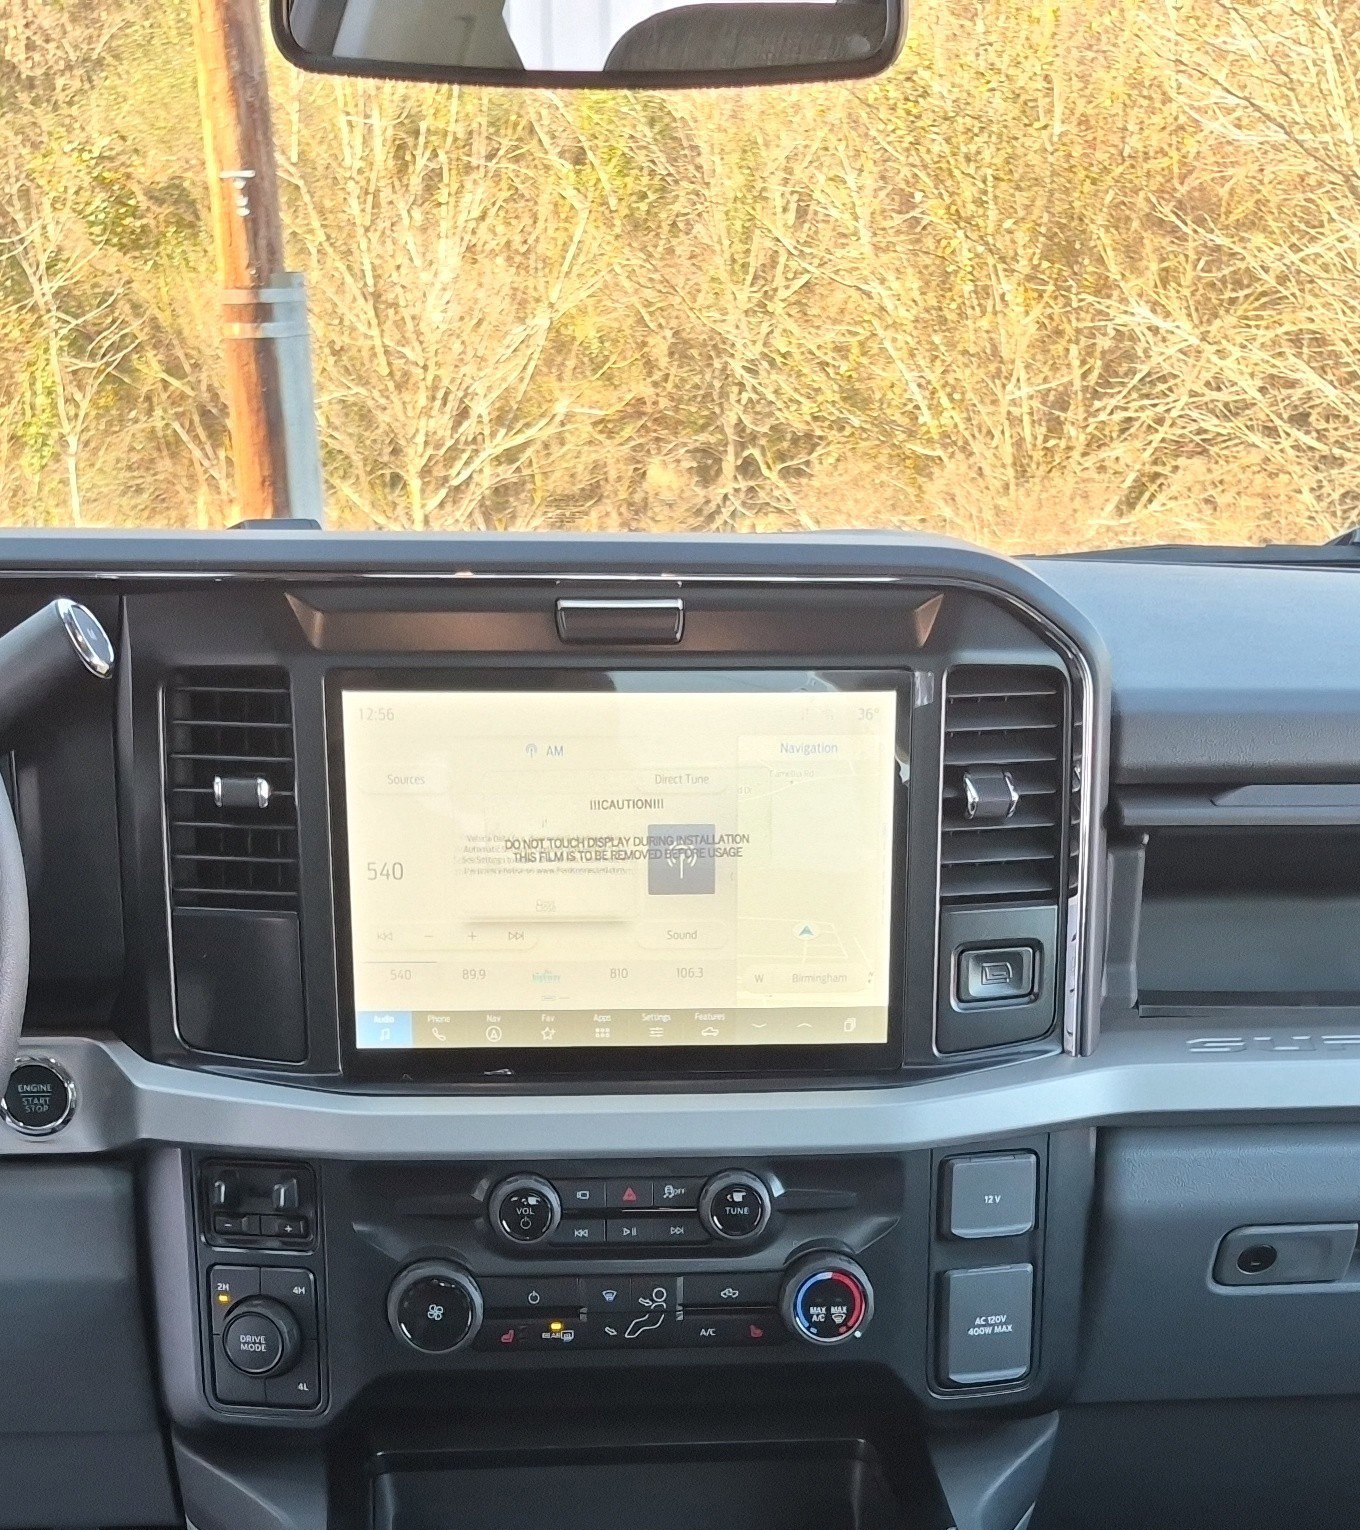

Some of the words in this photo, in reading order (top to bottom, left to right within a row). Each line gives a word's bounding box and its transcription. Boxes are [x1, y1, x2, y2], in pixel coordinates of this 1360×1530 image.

[358, 707, 395, 721] 12:56
[546, 745, 564, 757] AM
[779, 742, 839, 756] Navigation
[387, 774, 426, 786] Sources
[654, 773, 682, 785] Direct
[685, 773, 710, 785] Tune
[504, 839, 521, 850] DO
[523, 838, 546, 850] NOT
[547, 837, 585, 849] TOUCH
[587, 836, 631, 848] DISPLAY
[633, 835, 674, 847] DURING
[676, 834, 750, 846] INSTALLATION
[513, 851, 537, 863] THIS
[539, 851, 564, 863] FILM
[566, 851, 576, 862] IS
[577, 851, 593, 862] TO
[594, 850, 609, 861] BE
[610, 849, 662, 861] REMOVED
[664, 847, 707, 859] BEFORE
[708, 846, 743, 858] USAGE
[367, 861, 404, 881] 540
[666, 929, 698, 940] Sound
[389, 969, 412, 981] 540
[462, 968, 486, 981] 89.9
[609, 967, 629, 979] 810
[676, 967, 704, 979] 106.3
[754, 973, 765, 983] W
[792, 972, 848, 985] Birmingham
[373, 1015, 395, 1024] Audio
[427, 1014, 451, 1023] Phone
[486, 1014, 502, 1023] Nav
[541, 1014, 555, 1023] Fav
[593, 1013, 611, 1024] Apps
[641, 1012, 672, 1023] Settings
[694, 1011, 726, 1021] Features
[17, 1083, 52, 1093] ENGINE
[21, 1097, 50, 1105] START
[25, 1105, 49, 1113] STOP
[984, 1195, 994, 1204] 12
[994, 1195, 1001, 1203] V
[516, 1207, 535, 1216] VOL
[725, 1206, 749, 1215] TUNE
[216, 1283, 230, 1292] 2H
[292, 1286, 306, 1295] 4H
[809, 1306, 827, 1315] MAX
[830, 1305, 847, 1314] MAX
[812, 1314, 825, 1322] A/C
[975, 1316, 986, 1325] AC
[988, 1315, 1007, 1324] 120V
[699, 1328, 716, 1338] A/C
[968, 1326, 992, 1336] 400W
[994, 1324, 1013, 1333] MAX
[240, 1335, 266, 1344] DRIVE
[240, 1343, 267, 1352] MODE
[297, 1382, 309, 1391] 4L
